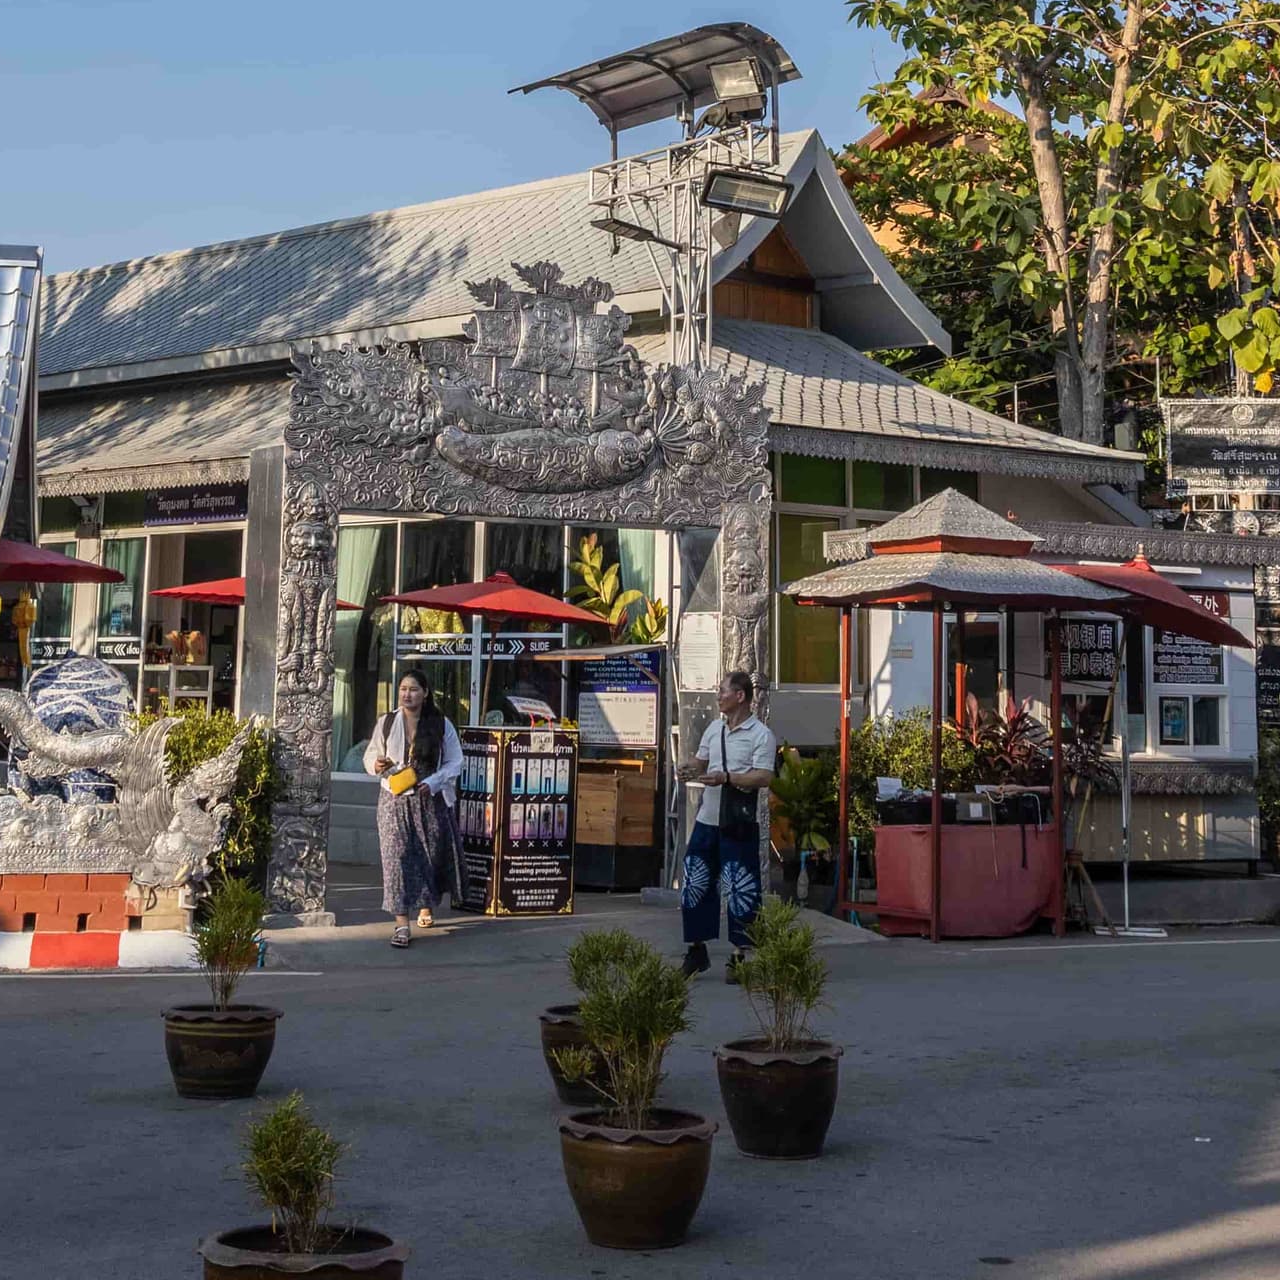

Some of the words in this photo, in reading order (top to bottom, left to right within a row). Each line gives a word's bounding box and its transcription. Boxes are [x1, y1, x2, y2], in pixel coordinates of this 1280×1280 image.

[420, 642, 439, 652] SLIDE
[529, 641, 550, 652] SLIDE
[1045, 651, 1117, 677] 票50泰铢
